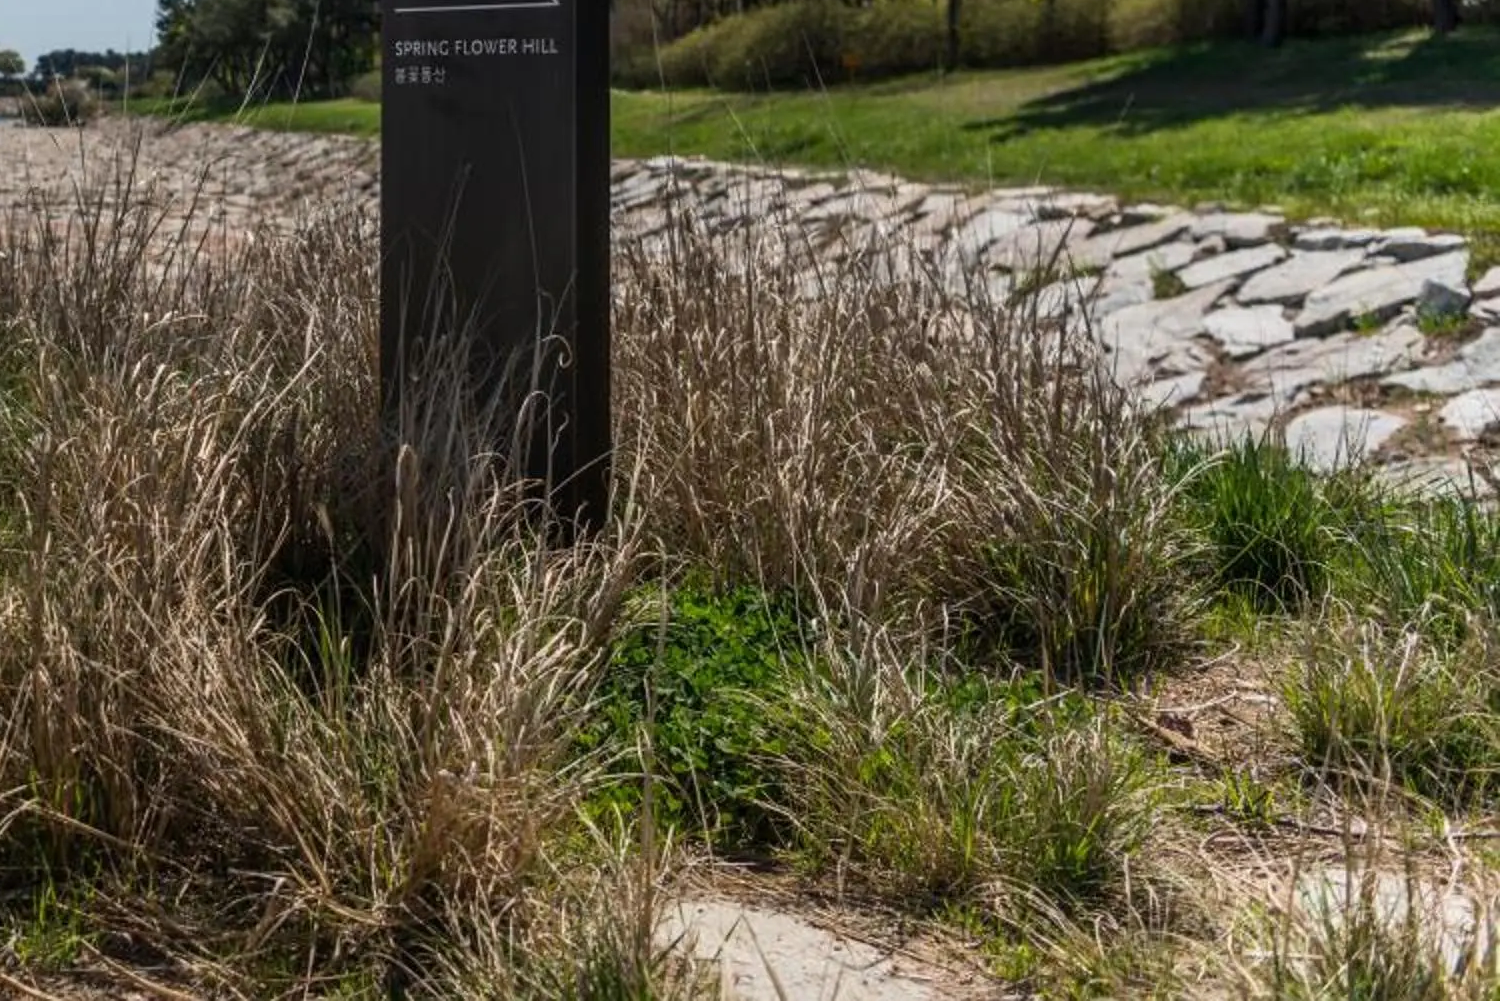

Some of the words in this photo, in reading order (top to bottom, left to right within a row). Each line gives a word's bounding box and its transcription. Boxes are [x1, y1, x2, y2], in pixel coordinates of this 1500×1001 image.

[395, 39, 449, 56] SPRING
[455, 38, 517, 56] FLOWER
[522, 38, 558, 54] HILL
